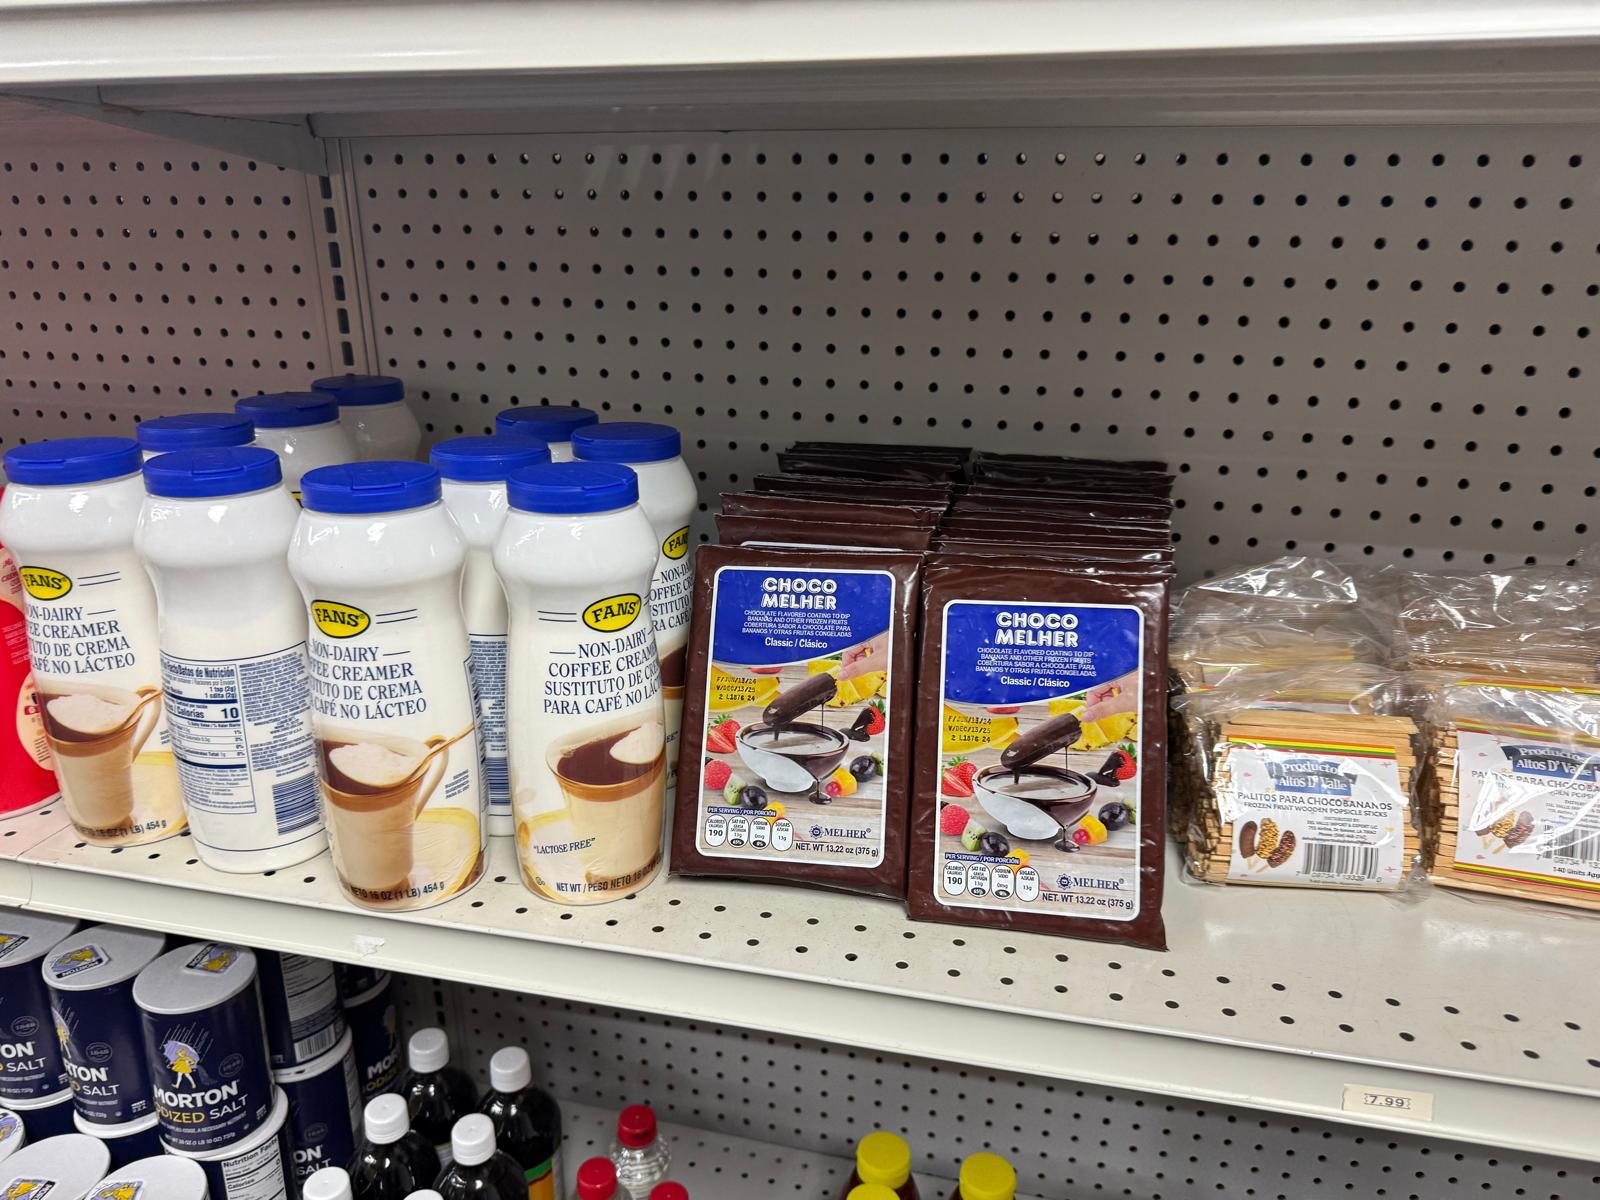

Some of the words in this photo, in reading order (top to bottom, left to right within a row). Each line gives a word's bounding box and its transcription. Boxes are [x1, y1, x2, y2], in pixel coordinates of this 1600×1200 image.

[668, 530, 688, 552] FAN
[661, 562, 690, 584] NON-DA
[23, 574, 62, 590] FANS
[762, 577, 837, 594] CHOCO
[650, 583, 682, 602] OFFEE
[761, 594, 837, 610] MELHER
[27, 604, 84, 621] ON-DAIRY
[314, 608, 360, 628] FANS
[592, 602, 637, 624] FANS
[777, 610, 806, 618] FLAVORED
[996, 612, 1078, 630] CHOCO
[43, 620, 121, 639] CREAMER
[815, 630, 852, 638] CONGELADAS
[994, 628, 1078, 648] MELHER
[54, 643, 72, 657] DE
[75, 636, 130, 656] CREMA
[578, 628, 648, 659] NON-DAIRY
[765, 636, 794, 648] Classic
[800, 638, 828, 648] Clásico
[1014, 648, 1045, 656] FLAVORED
[52, 660, 70, 674] NO
[74, 653, 135, 674] LÁCTEO
[332, 662, 414, 682] CREAMER
[548, 660, 612, 678] COFFEE
[1041, 662, 1077, 670] CHOCOLATE
[1055, 669, 1097, 677] CONGELADAS
[343, 685, 363, 701] DE
[368, 680, 422, 700] CREMA
[544, 676, 625, 696] SUSTITUTO
[628, 670, 642, 689] DE
[1000, 676, 1032, 686] Classic
[1038, 677, 1070, 688] Clásico
[340, 704, 360, 720] NO
[365, 697, 427, 720] LÁCTEO
[544, 698, 582, 714] PARA
[585, 692, 622, 714] CAFÉ
[626, 688, 642, 708] NO
[220, 708, 238, 719] 10
[1283, 761, 1342, 775] Producto
[1516, 759, 1546, 770] Altos
[1279, 775, 1305, 788] Altos
[1516, 776, 1546, 786] PARA
[1238, 792, 1277, 802] PALITOS
[1279, 795, 1306, 805] PARA
[1307, 797, 1392, 812] CHOCOBANANOS
[1244, 802, 1272, 810] FROZEN
[1294, 805, 1328, 814] WOODEN
[1330, 808, 1362, 817] POPSICLE
[1364, 810, 1388, 818] STICKS
[146, 820, 160, 830] 454
[824, 828, 867, 839] MELHER
[795, 842, 812, 852] NET.
[813, 844, 824, 852] WT
[826, 844, 844, 854] 13.22
[855, 846, 870, 856] (375
[871, 848, 880, 858] g)
[556, 882, 568, 892] NET
[570, 883, 581, 893] WT
[588, 882, 609, 892] PESO
[610, 874, 632, 889] NETO
[947, 876, 963, 884] 190
[1073, 878, 1120, 890] MELHER
[380, 890, 393, 900] OZ
[406, 888, 421, 898] LB)
[422, 882, 438, 894] 454
[440, 882, 445, 890] g
[1042, 892, 1059, 902] NET.
[1060, 894, 1074, 903] WT
[1075, 896, 1095, 906] 13.22
[1108, 898, 1124, 908] (375
[1125, 900, 1134, 910] g)
[7, 1056, 48, 1072] SALT
[64, 1058, 108, 1082] RTON
[83, 1084, 120, 1096] SALT
[153, 1080, 239, 1108] MORTON
[156, 1103, 205, 1124] ODIZED
[209, 1094, 249, 1120] SALT
[1370, 1095, 1404, 1107] 7.99
[223, 1152, 259, 1168] Nutrition
